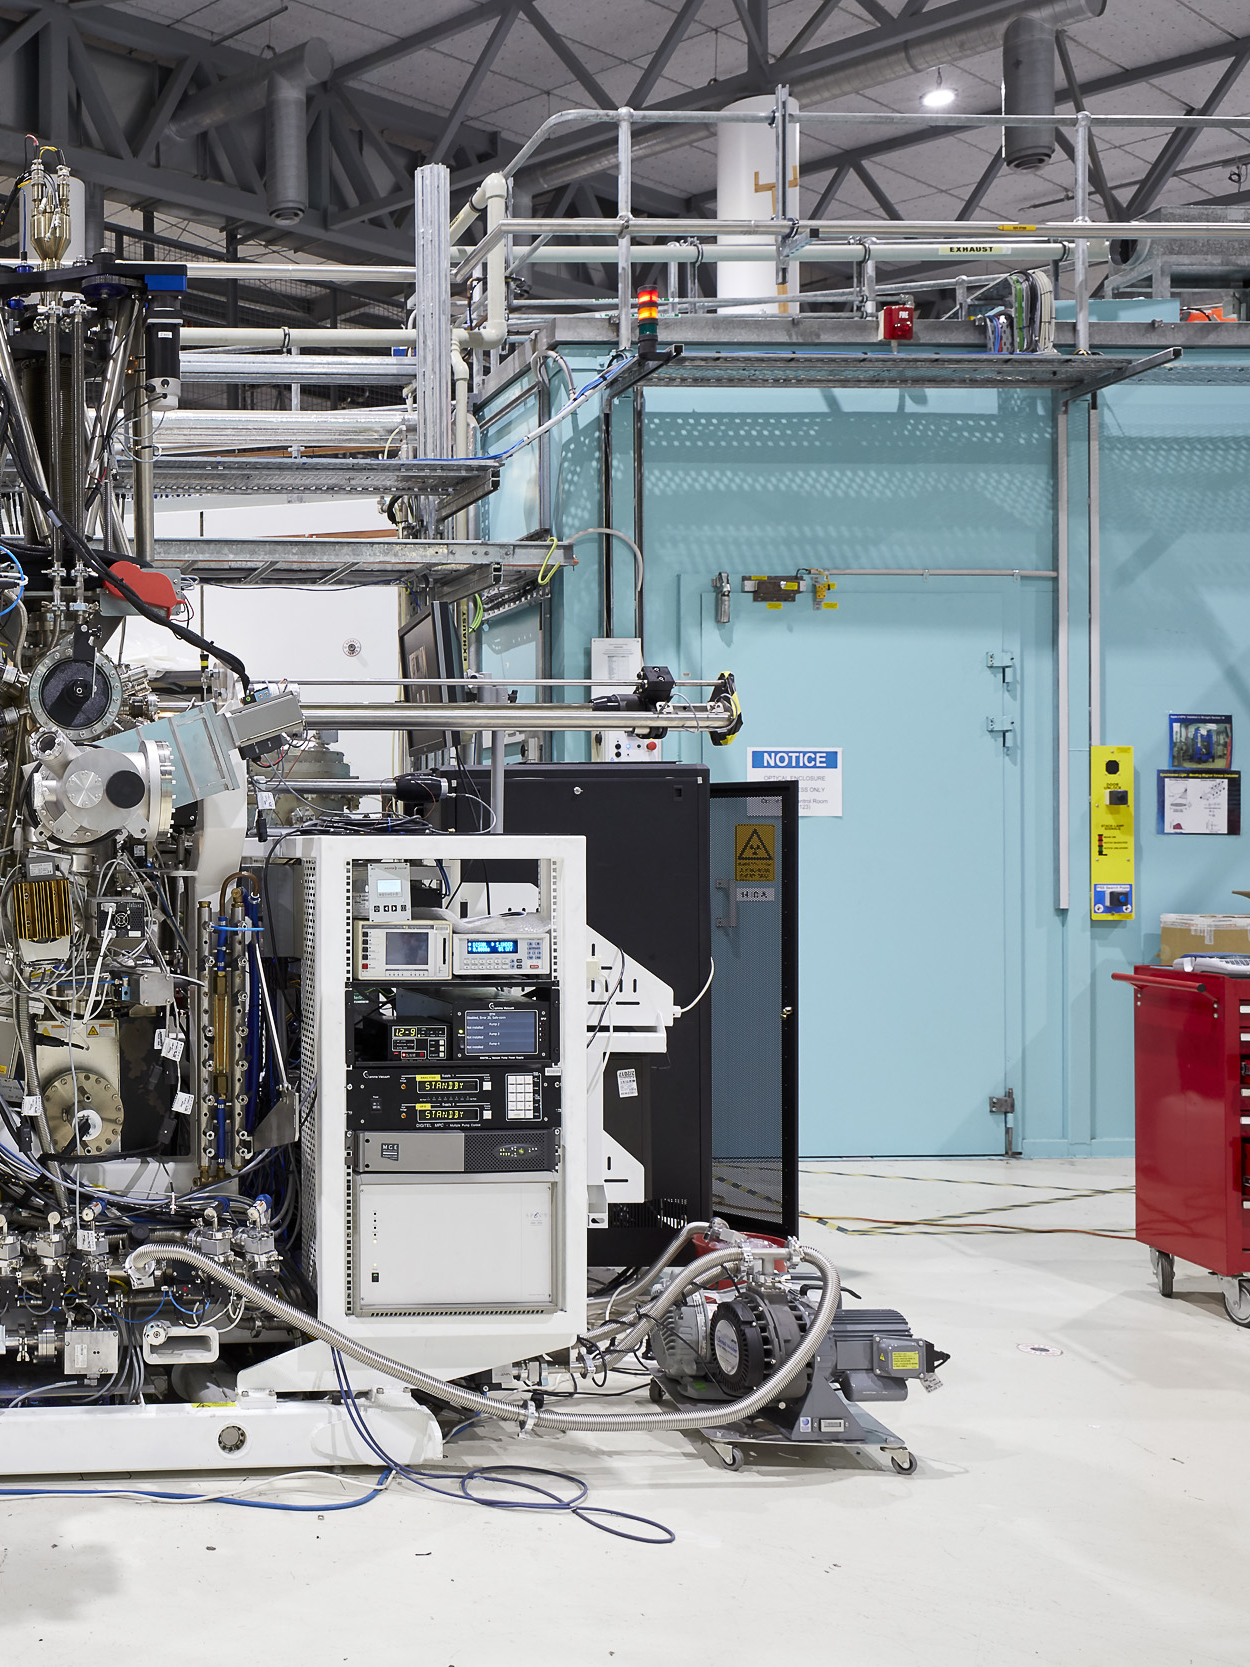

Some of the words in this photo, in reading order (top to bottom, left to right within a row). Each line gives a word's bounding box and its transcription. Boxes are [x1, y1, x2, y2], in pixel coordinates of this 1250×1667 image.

[898, 311, 909, 319] FIRE
[763, 752, 827, 767] NOTICE
[425, 1081, 464, 1091] STANDBY
[425, 1110, 464, 1119] STANDBY
